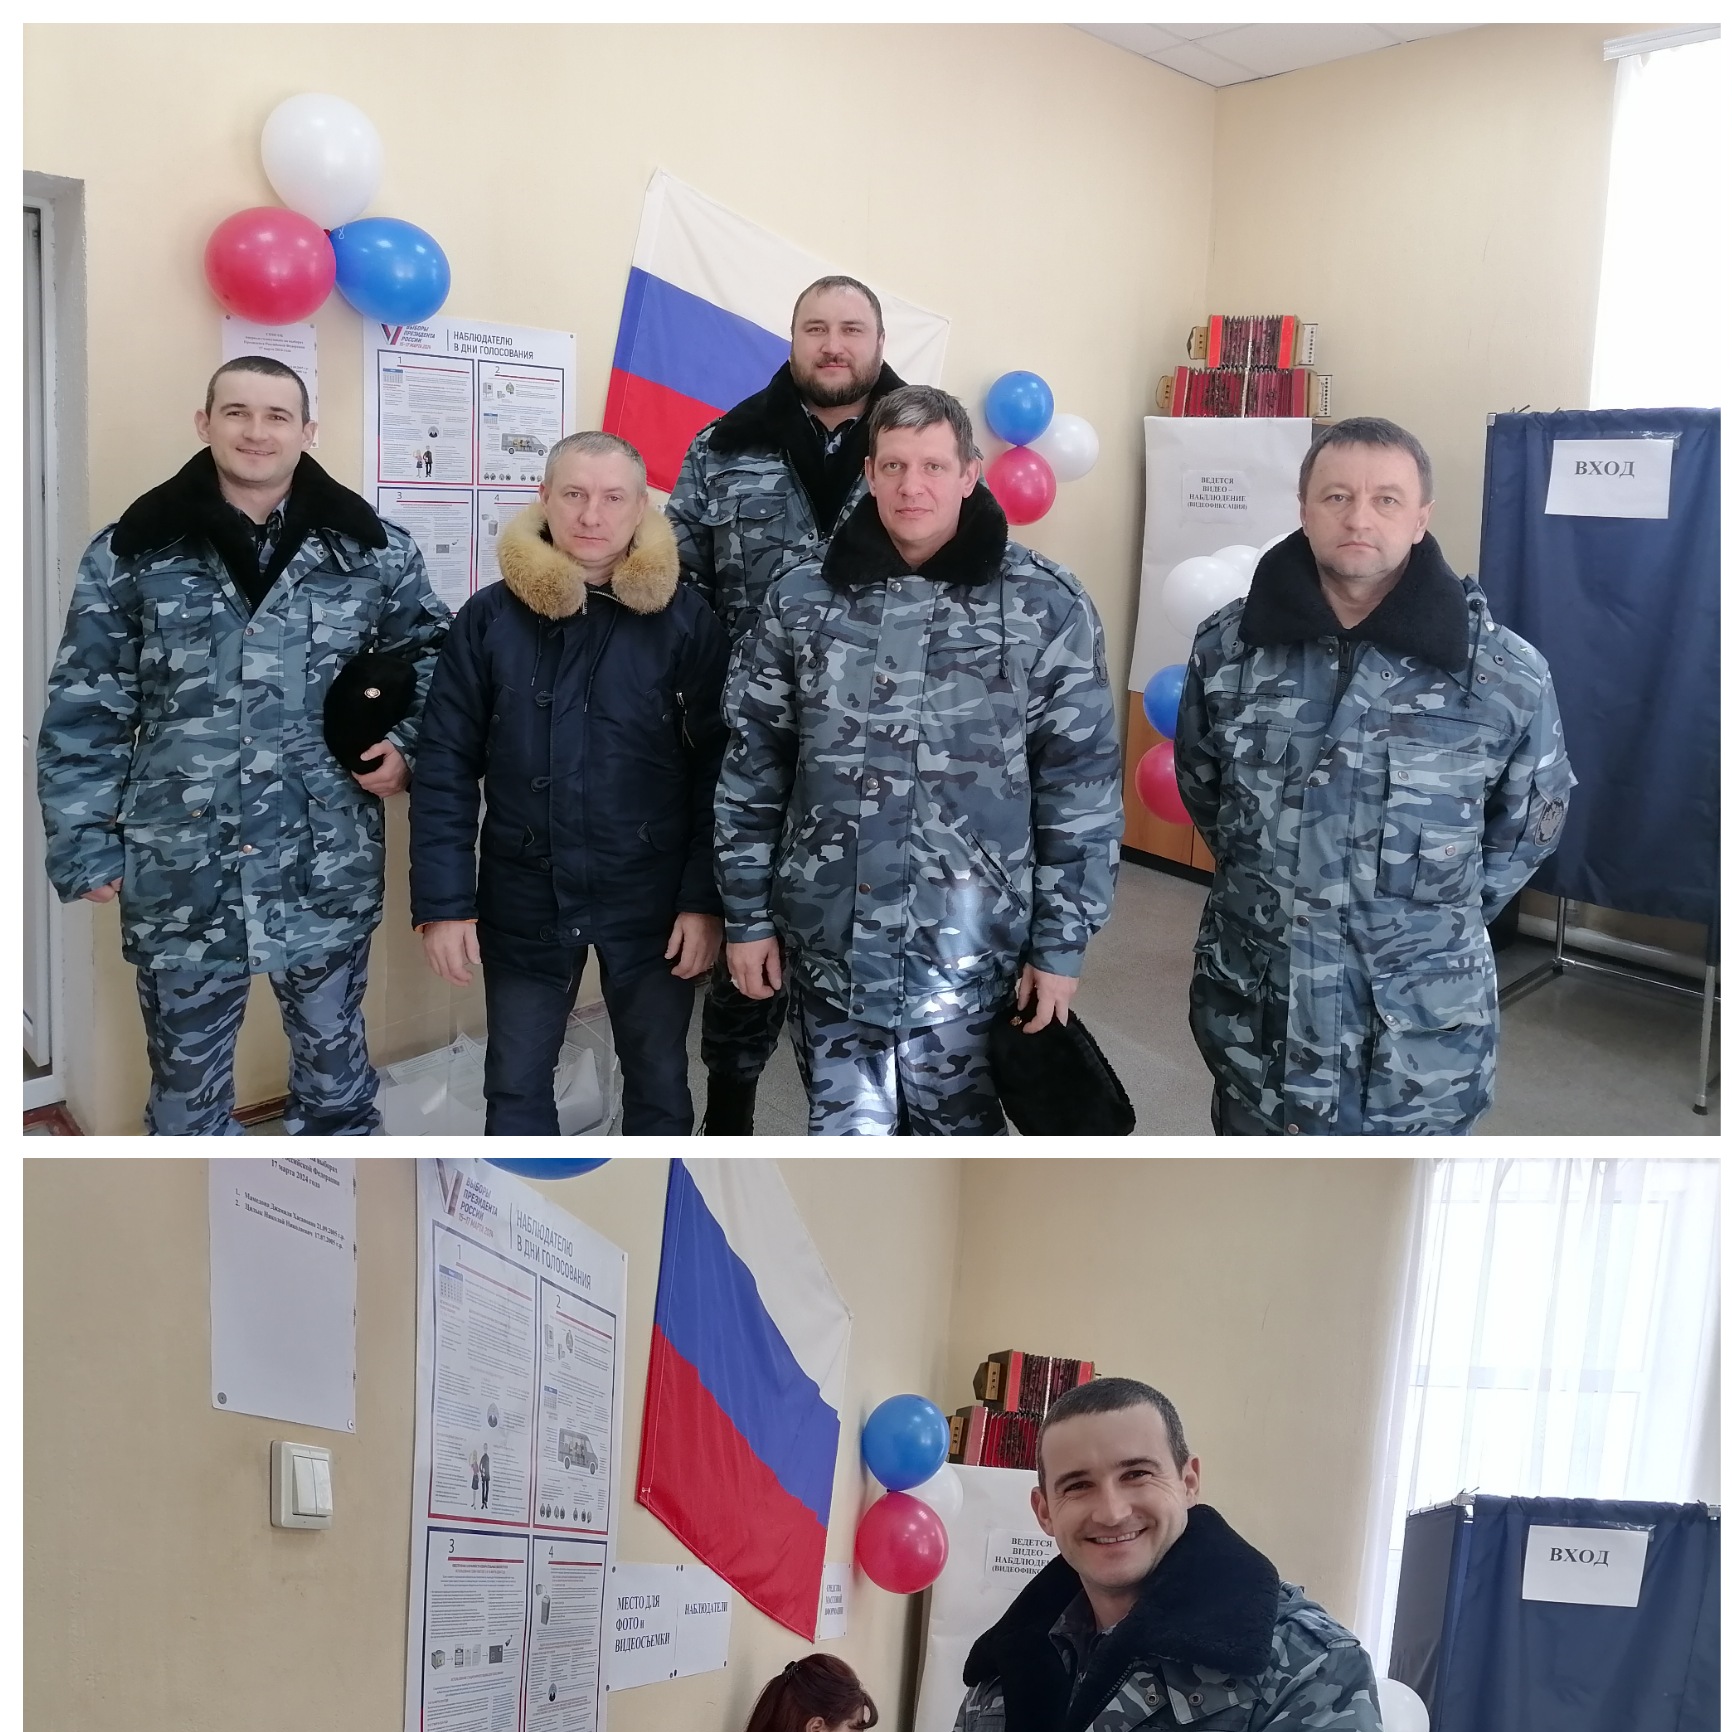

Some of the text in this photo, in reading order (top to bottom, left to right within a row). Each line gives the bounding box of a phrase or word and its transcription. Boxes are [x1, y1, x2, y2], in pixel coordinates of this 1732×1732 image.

[454, 331, 512, 346] НАБЛЮДАТЕЛЮ
[454, 343, 533, 359] В ДНИ ГОЛОСОВАНИЯ
[1574, 460, 1635, 478] ВХОД
[466, 1177, 491, 1198] ВЫБОРЫ
[463, 1189, 498, 1216] ПРЕЗИДЕНТА
[460, 1200, 483, 1221] РОССИИ
[516, 1210, 573, 1257] НАБЛЮДАТЕЛЮ
[457, 1244, 461, 1259] 1
[517, 1235, 591, 1290] В ДНИ ГОЛОСОВАНИЯ
[556, 1295, 560, 1309] 2
[448, 1539, 454, 1553] 3
[1011, 1538, 1052, 1547] ВЕДЕТСЯ
[549, 1546, 553, 1559] 4
[1012, 1548, 1043, 1556] ВИДЕО
[1549, 1547, 1610, 1567] ВХОД
[995, 1556, 1050, 1567] НАБДЛЮДЕ
[617, 1595, 660, 1611] МЕСТО ДЛЯ
[684, 1601, 728, 1615] НАБЛЮДАТЕЛИ
[616, 1617, 644, 1631] ФОТО и
[615, 1632, 670, 1653] ВИДЕОСЪЕМКИ
